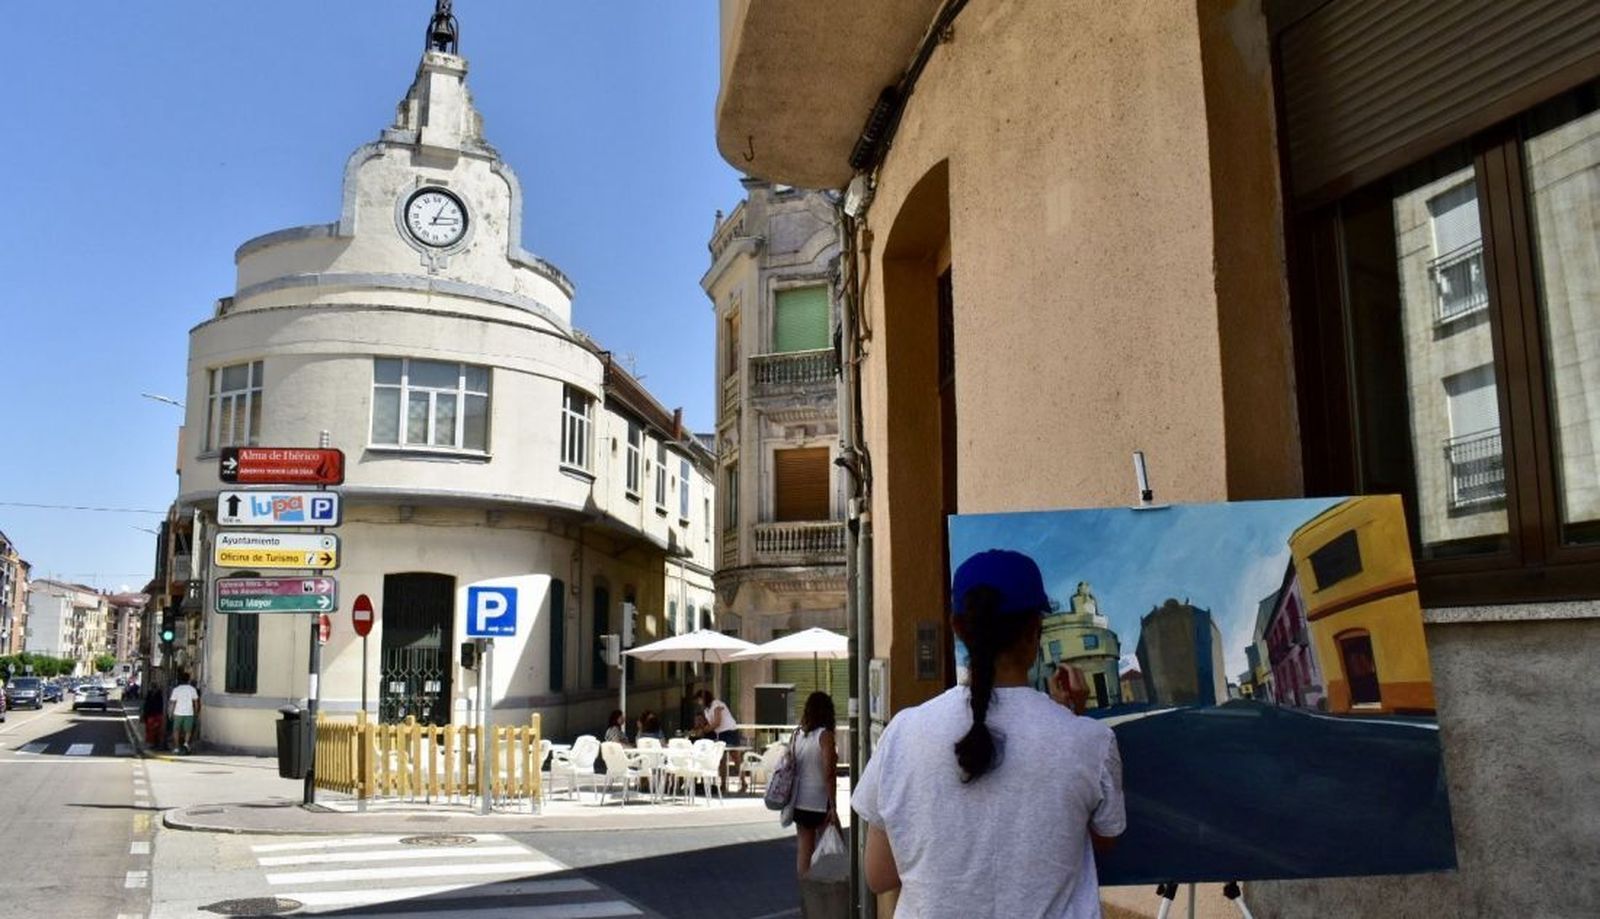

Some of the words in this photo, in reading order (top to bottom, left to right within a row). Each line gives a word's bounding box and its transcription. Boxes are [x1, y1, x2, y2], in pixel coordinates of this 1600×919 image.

[240, 450, 267, 460] Alma
[268, 450, 280, 460] de
[281, 450, 319, 461] Ibérico
[250, 494, 304, 521] lupa
[314, 499, 331, 518] P
[221, 536, 280, 546] Ayuntamiento
[220, 552, 250, 562] Oficina
[252, 552, 263, 562] de
[265, 553, 299, 563] Turismo
[220, 598, 244, 608] Plaza
[245, 598, 273, 609] Mayor
[477, 591, 508, 631] P
